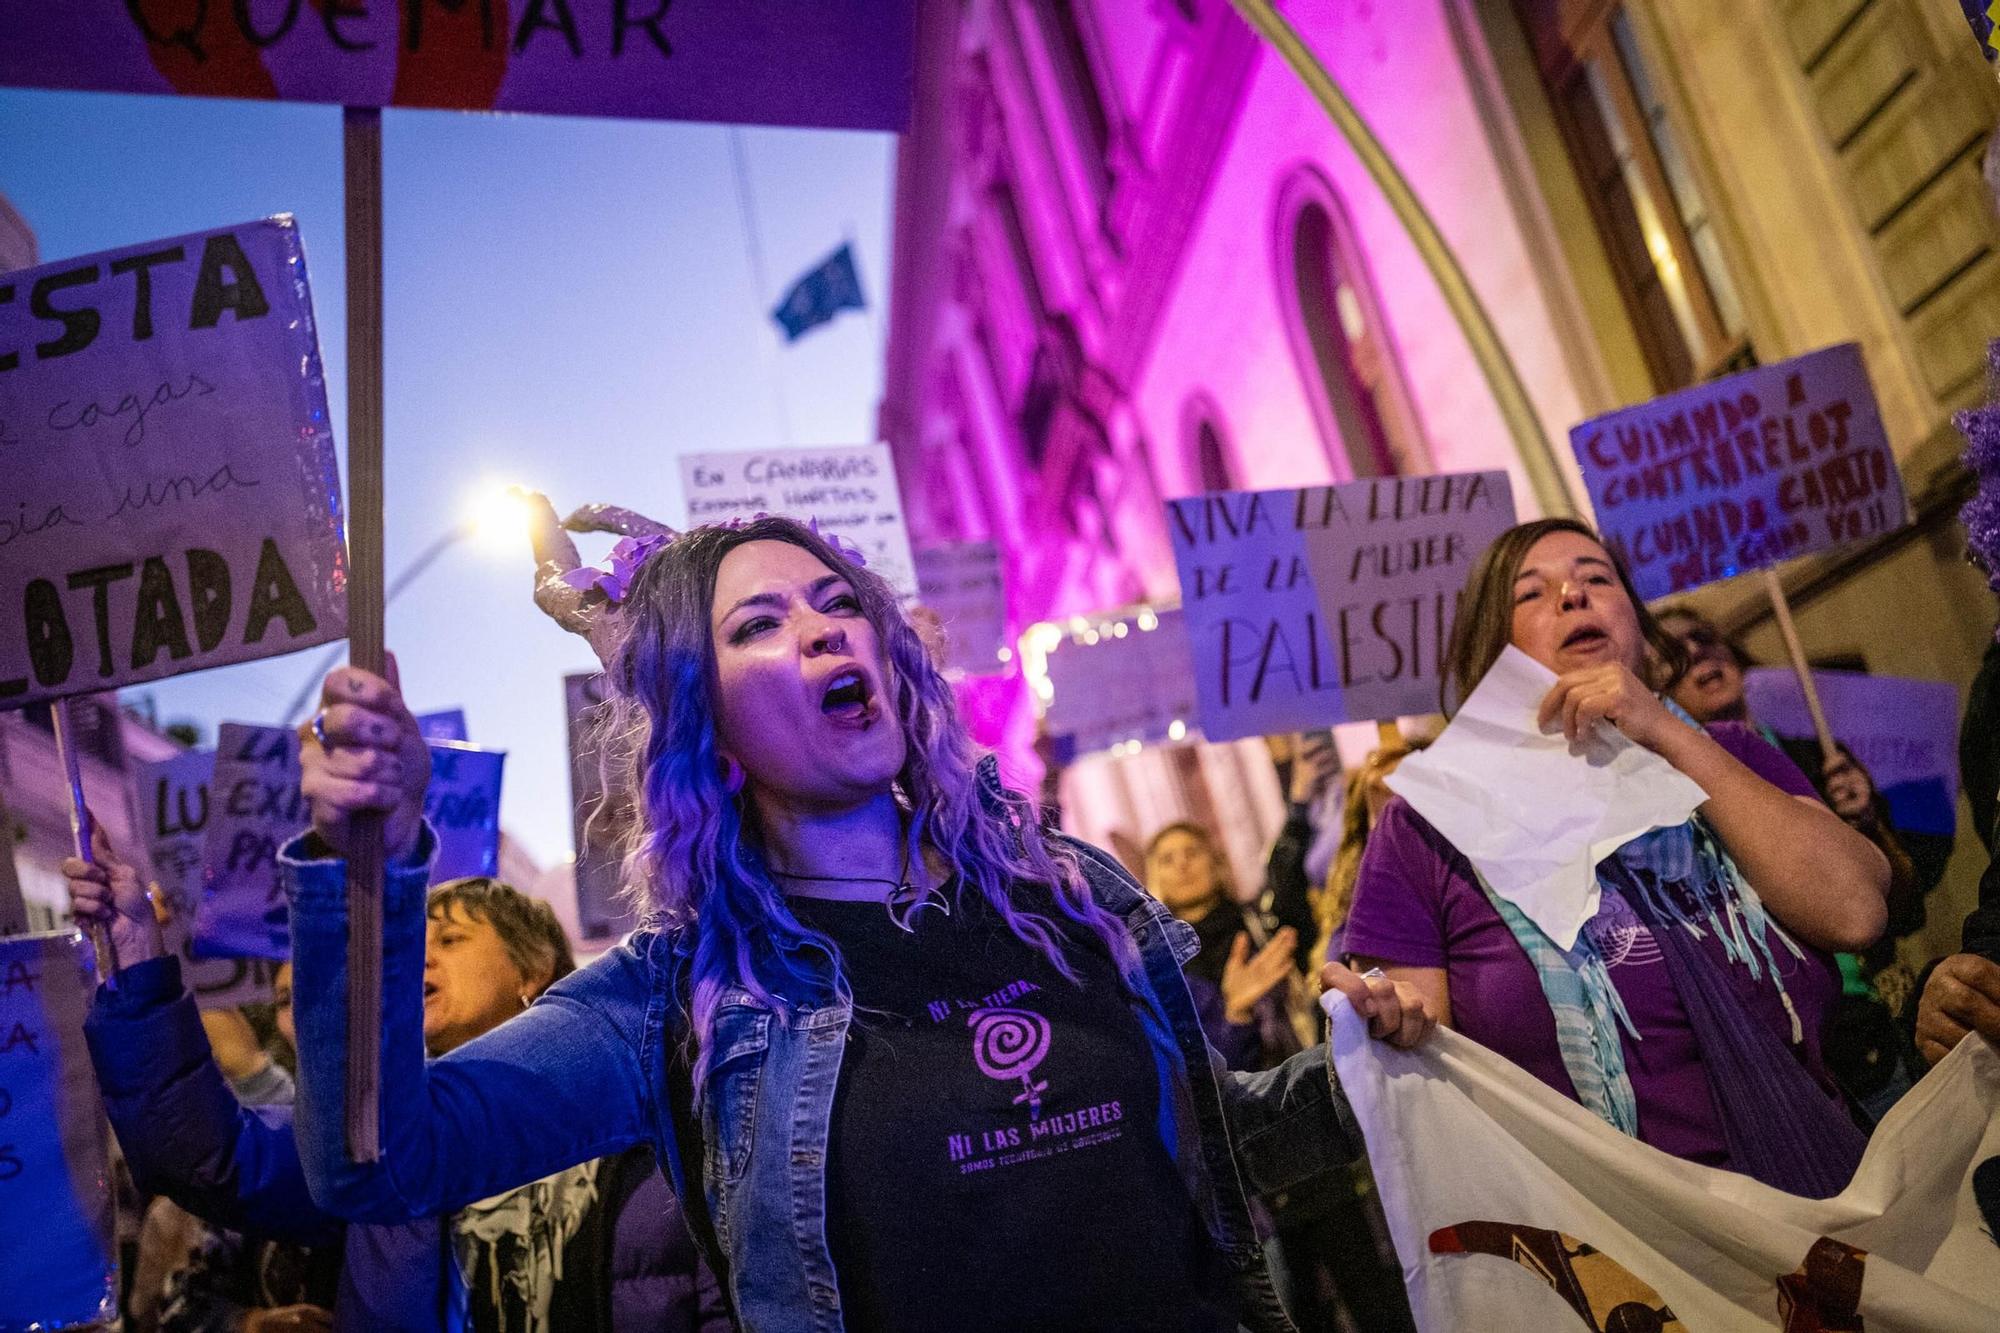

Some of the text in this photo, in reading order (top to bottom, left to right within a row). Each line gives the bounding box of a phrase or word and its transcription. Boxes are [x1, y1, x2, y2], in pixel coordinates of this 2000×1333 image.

[1166, 492, 1278, 547] VIVA
[1294, 486, 1350, 531] LA
[1348, 530, 1469, 585] MUJER
[947, 1099, 1123, 1162] NI LAS MUJERES
